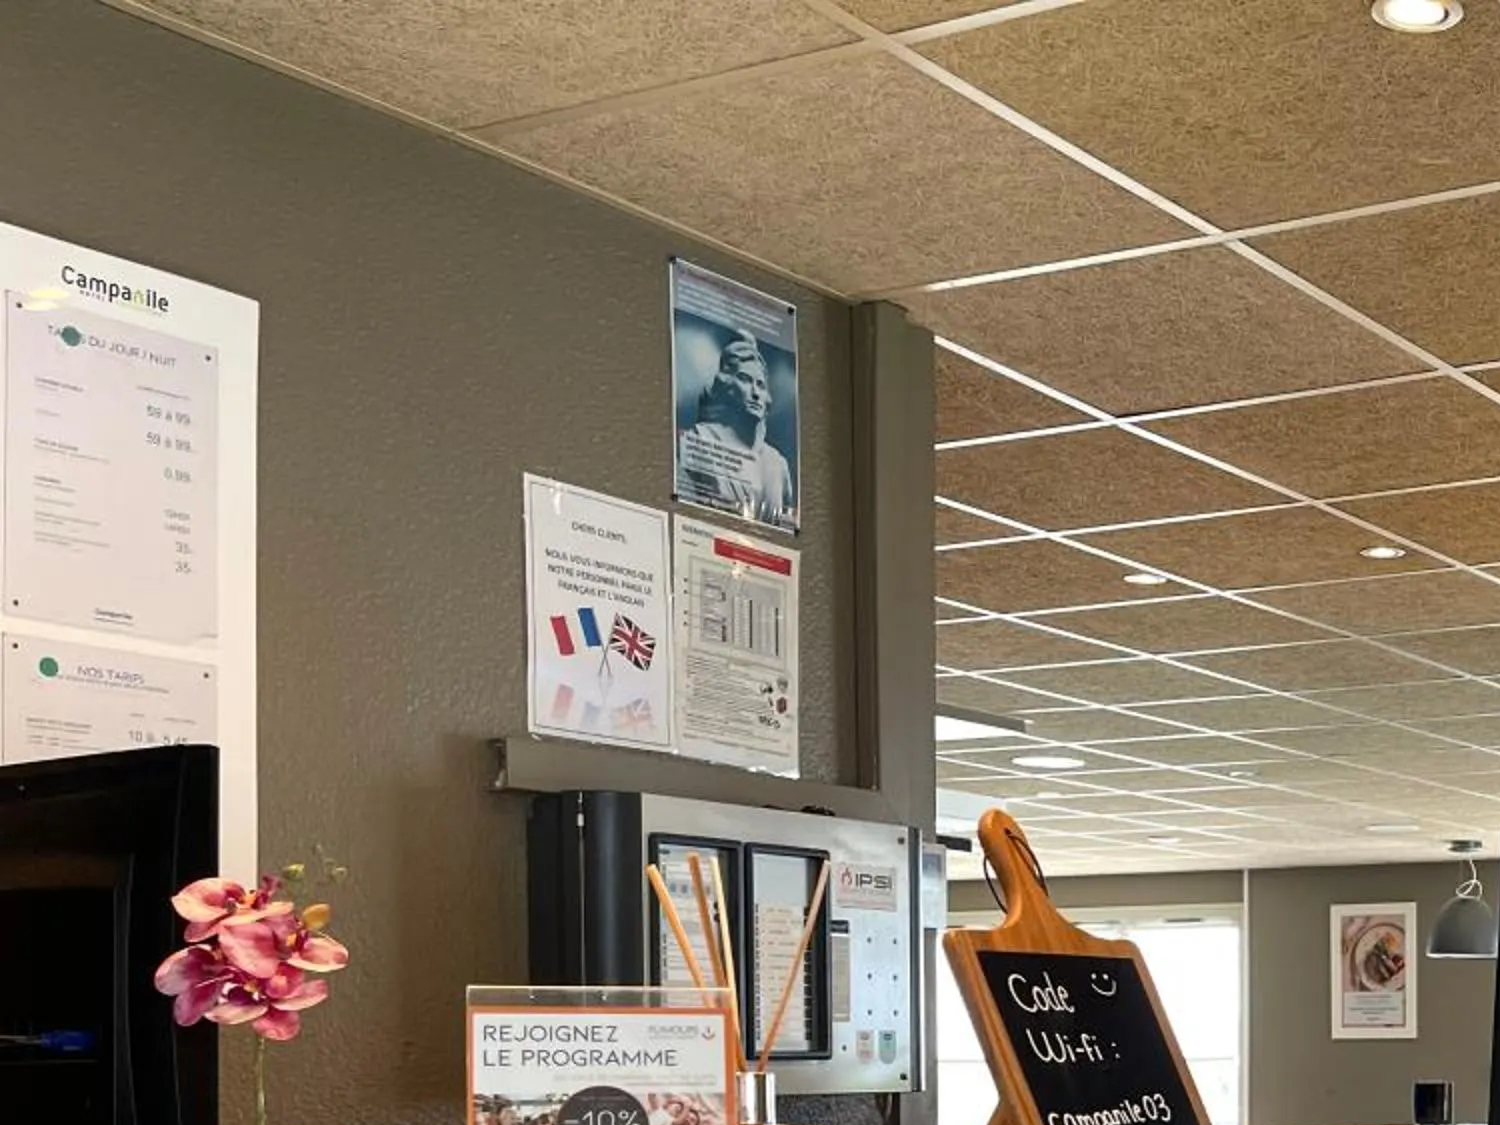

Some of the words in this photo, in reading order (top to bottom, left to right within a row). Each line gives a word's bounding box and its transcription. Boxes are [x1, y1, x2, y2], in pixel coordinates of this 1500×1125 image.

[61, 265, 169, 312] Campanile
[854, 871, 893, 890] IPSI
[1007, 971, 1075, 1013] Code
[483, 1024, 619, 1043] REJOIGNEZ
[483, 1049, 512, 1067] LE
[520, 1049, 678, 1067] PROGRAMME
